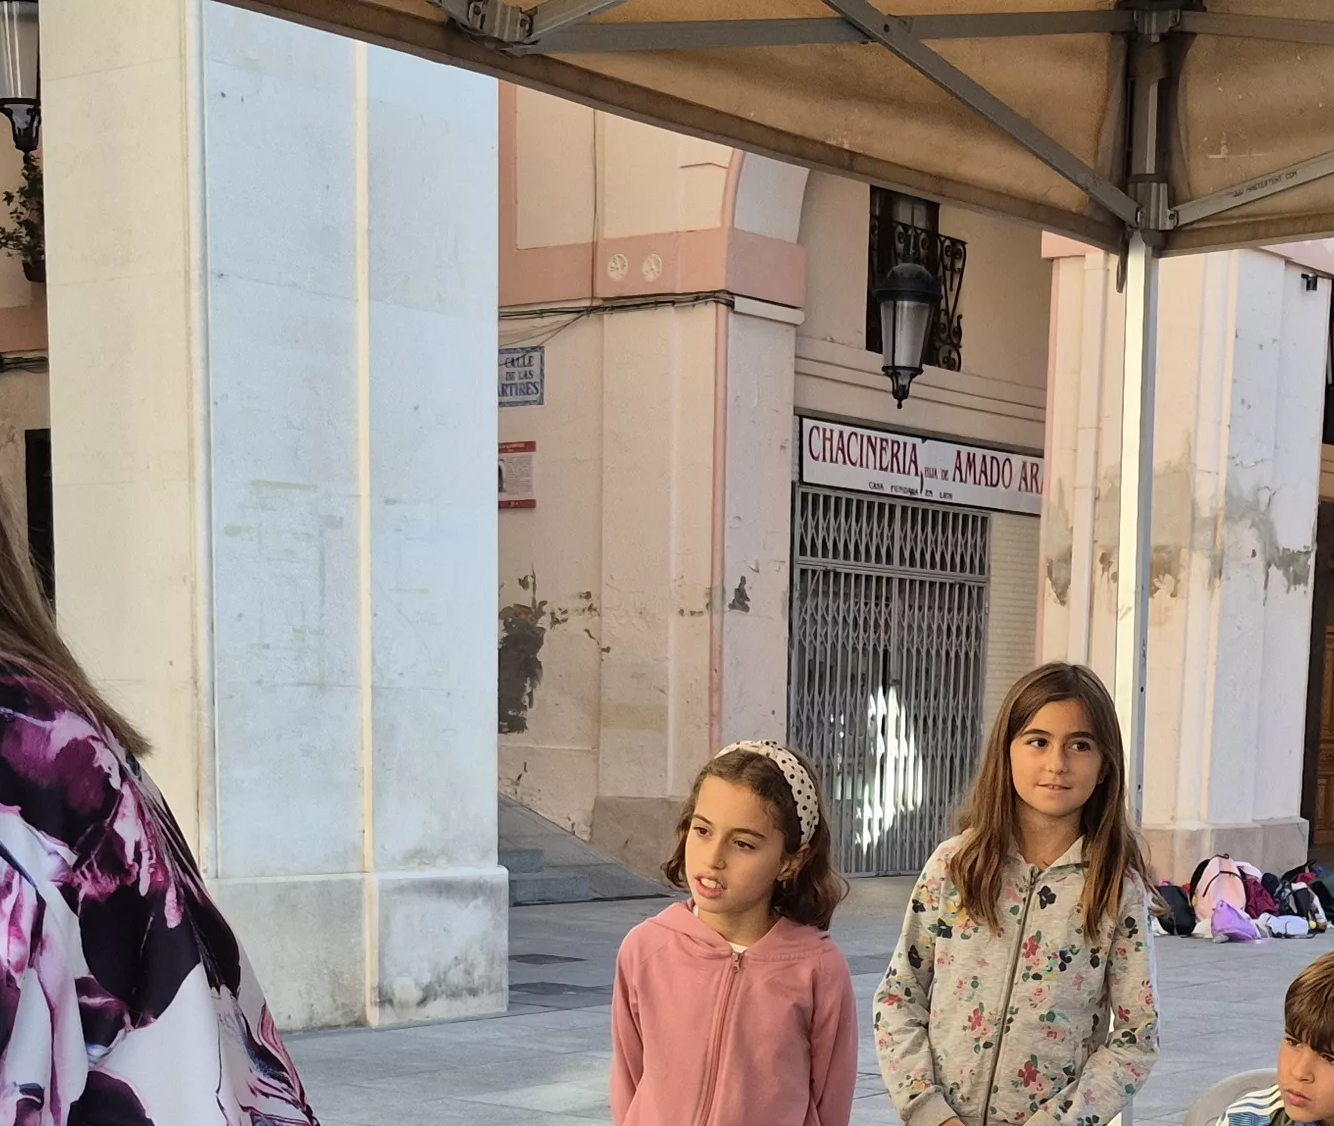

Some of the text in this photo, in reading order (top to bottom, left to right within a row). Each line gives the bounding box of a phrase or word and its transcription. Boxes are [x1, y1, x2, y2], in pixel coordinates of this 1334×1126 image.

[505, 355, 534, 368] CALLE
[518, 370, 534, 380] LAS
[951, 449, 1014, 490] AMADO
